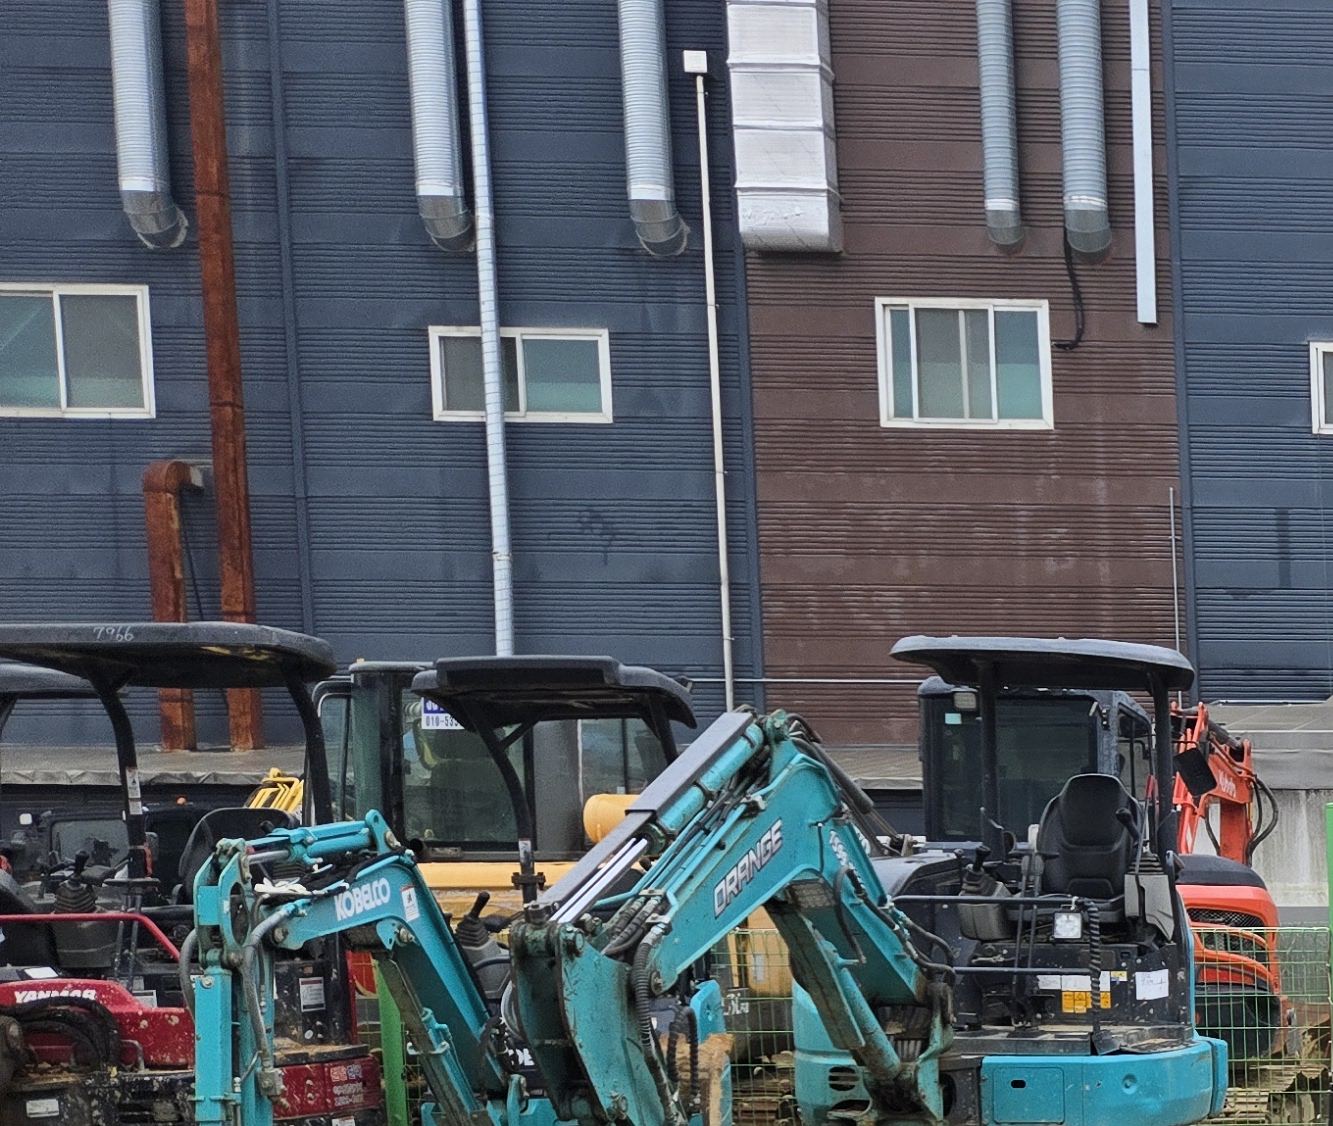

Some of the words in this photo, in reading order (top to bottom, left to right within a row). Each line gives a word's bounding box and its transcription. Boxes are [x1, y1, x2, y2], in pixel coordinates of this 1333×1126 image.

[93, 626, 134, 641] 7966
[714, 817, 783, 919] ORANGE
[334, 877, 391, 921] KOBELCO
